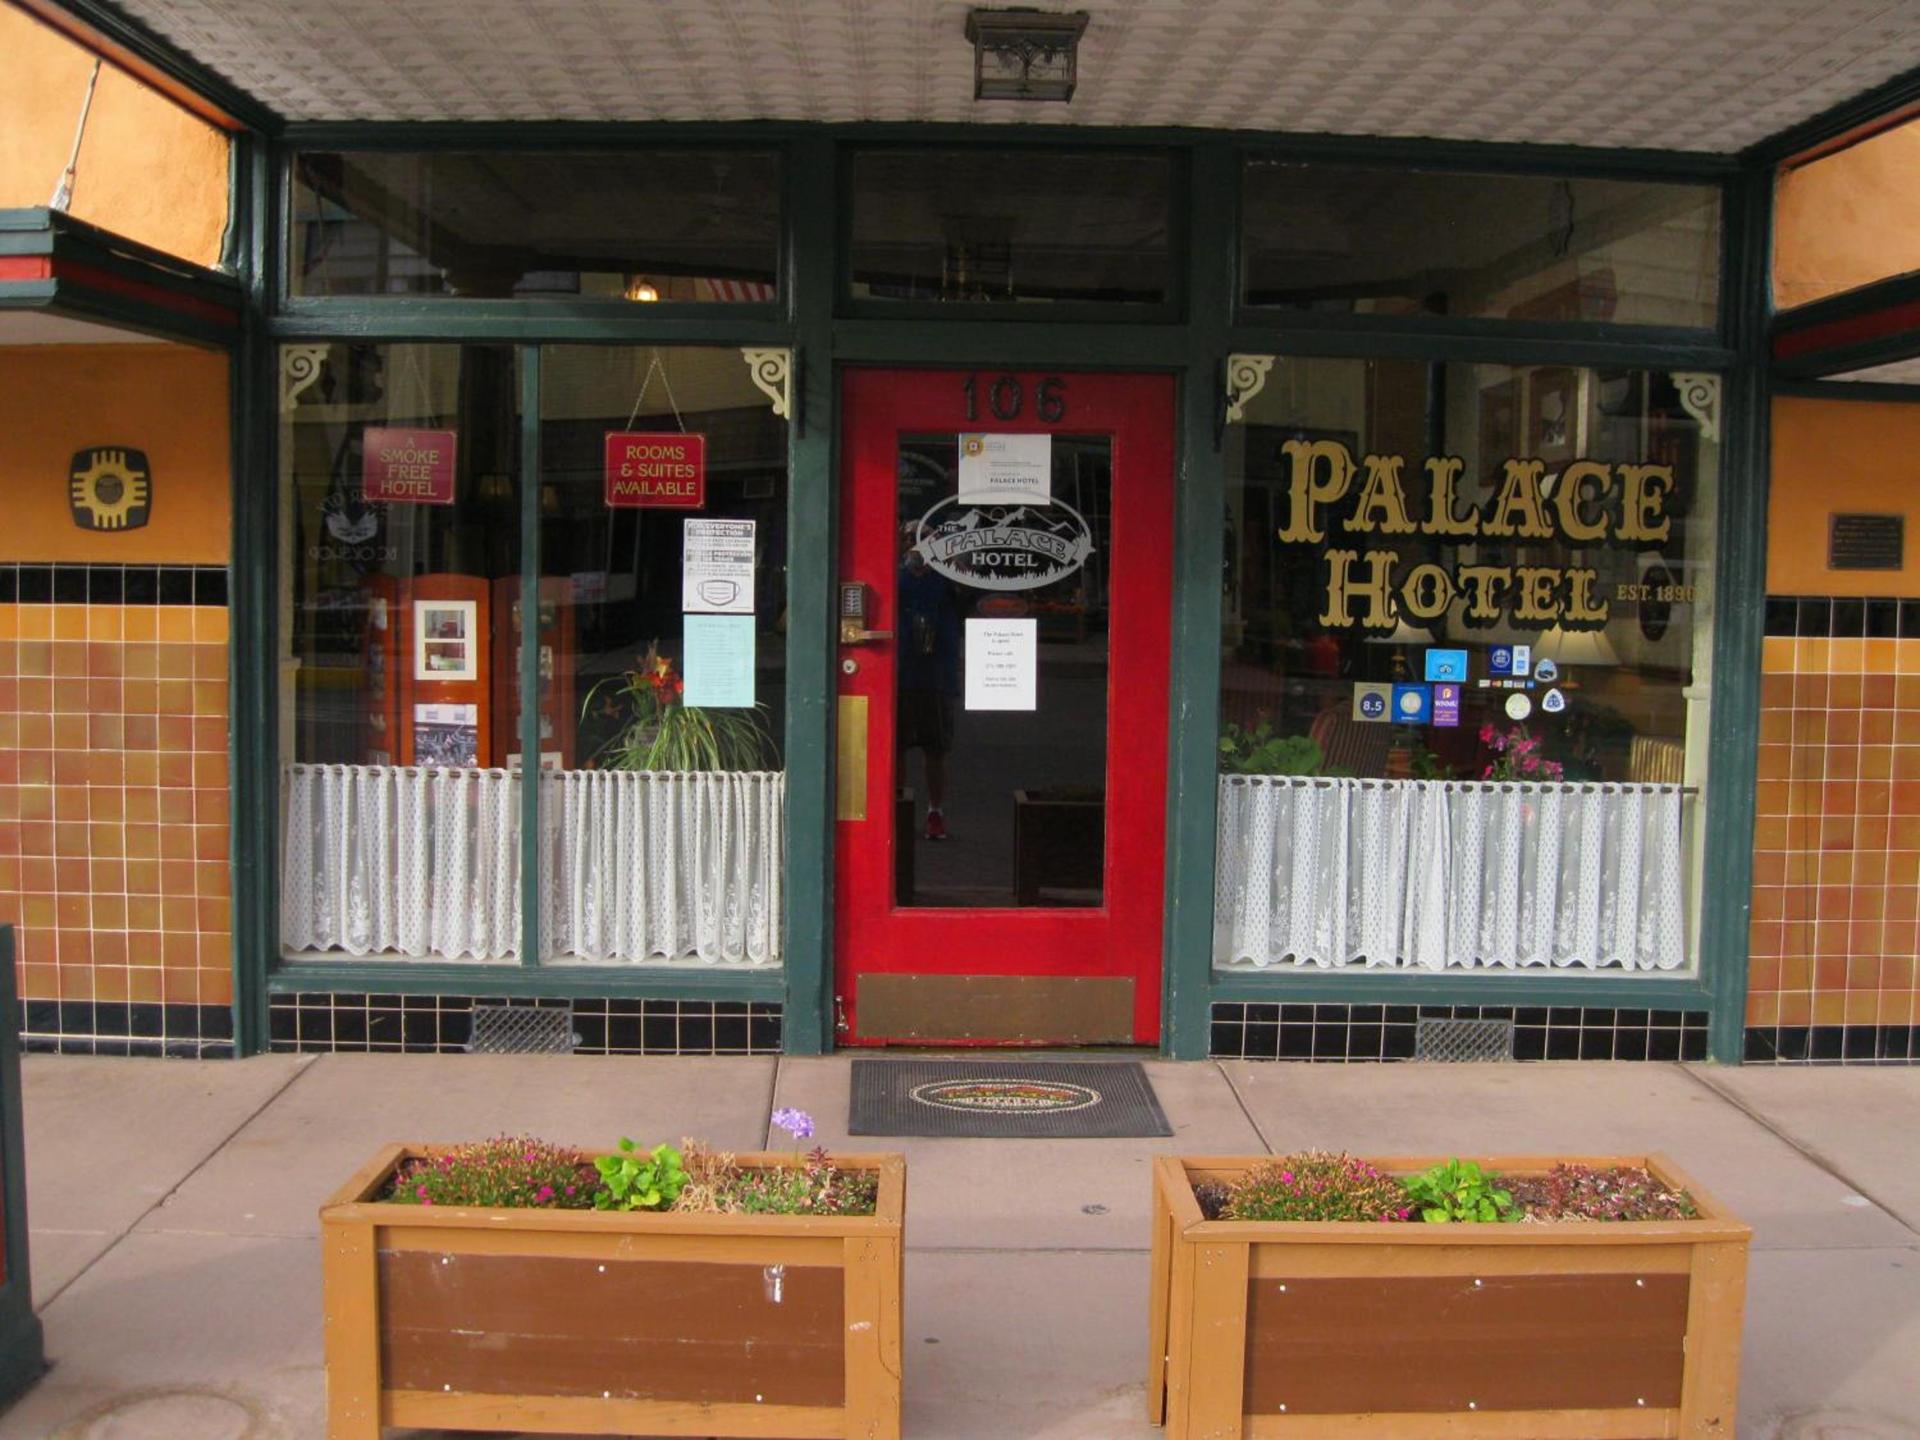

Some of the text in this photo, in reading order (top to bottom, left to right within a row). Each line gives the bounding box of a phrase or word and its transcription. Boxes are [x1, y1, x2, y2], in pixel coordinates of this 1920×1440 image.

[963, 377, 1067, 422] 106
[405, 437, 415, 449] A
[380, 449, 439, 465] SMOKE
[626, 445, 685, 460] ROOMS
[388, 465, 431, 481] FREE
[620, 463, 696, 477] & SUITES
[380, 480, 438, 497] HOTEL
[613, 481, 697, 496] AVAILABLE
[1277, 439, 1675, 544] PALACE
[944, 527, 1066, 560] PALACE
[971, 551, 1039, 567] HOTEL
[1319, 548, 1609, 629] HOTEL
[1616, 584, 1697, 603] EST. 1890
[1362, 700, 1383, 711] 8.5
